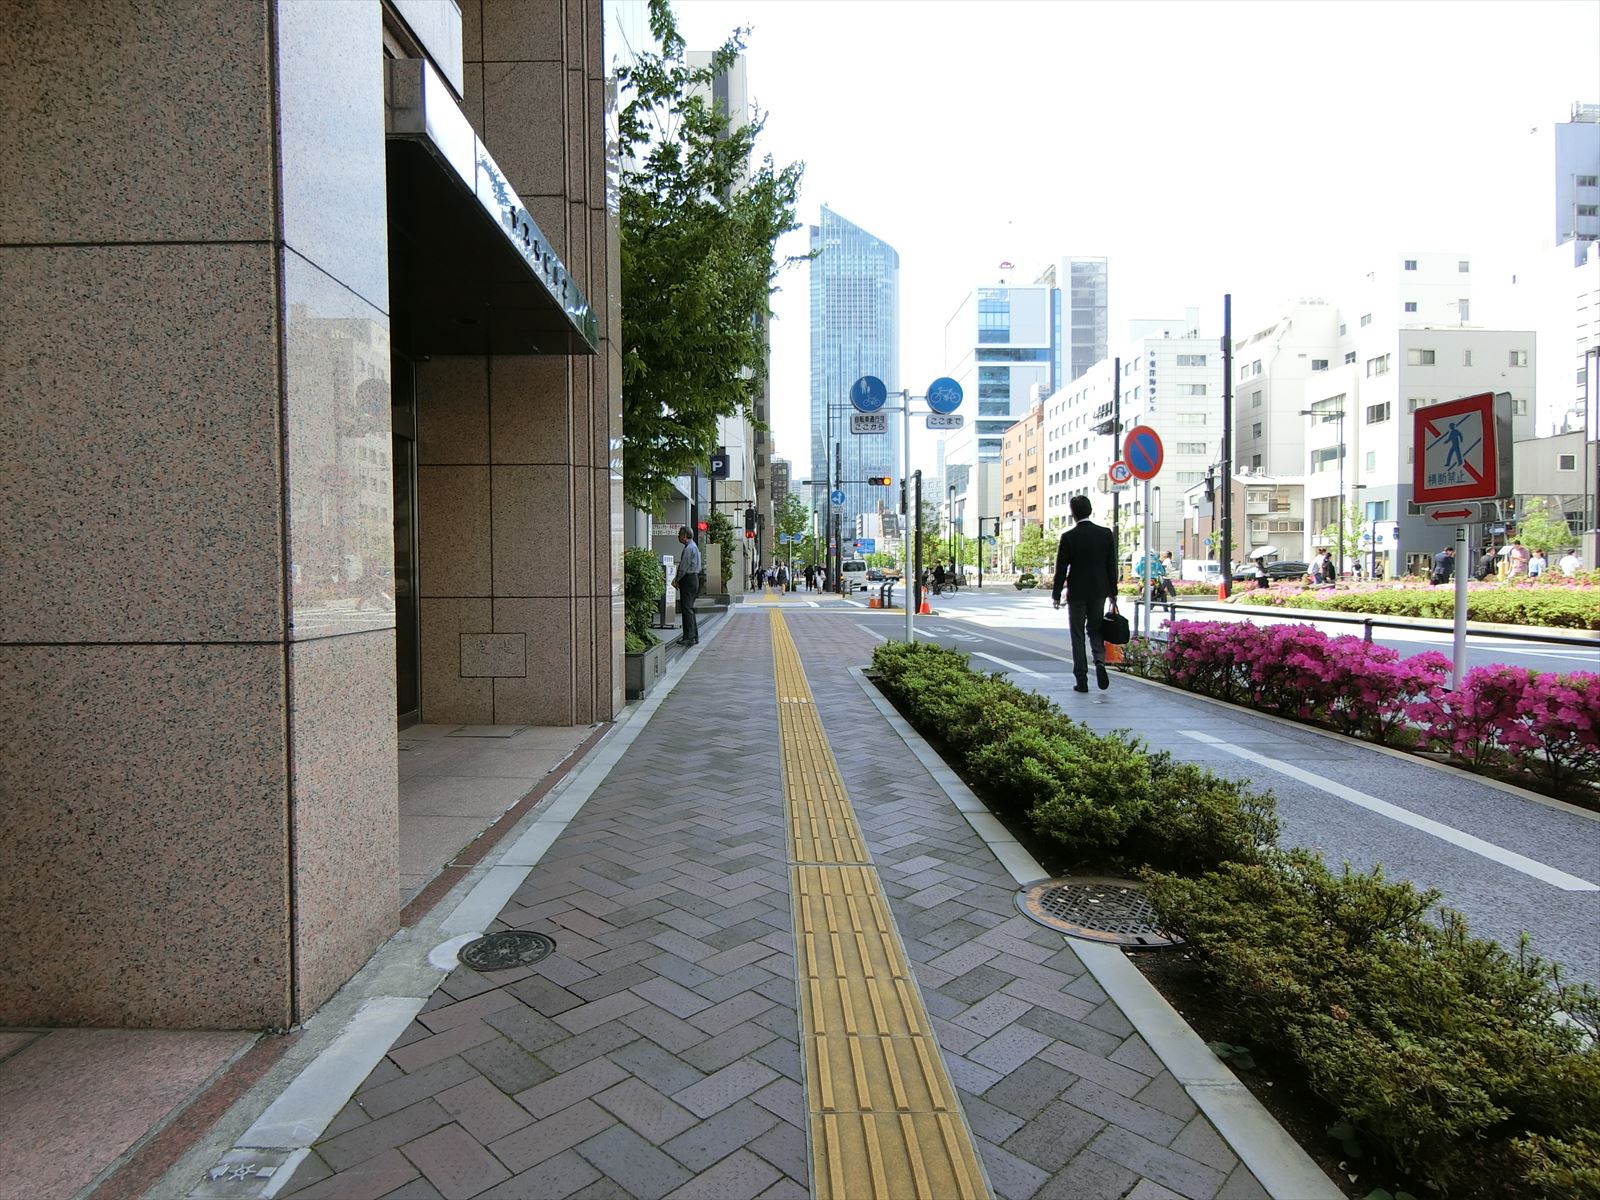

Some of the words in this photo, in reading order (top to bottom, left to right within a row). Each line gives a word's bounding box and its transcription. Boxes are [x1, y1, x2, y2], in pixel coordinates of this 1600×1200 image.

[930, 417, 961, 425] ここまで
[712, 461, 723, 472] P
[1428, 471, 1466, 485] 横断禁止
